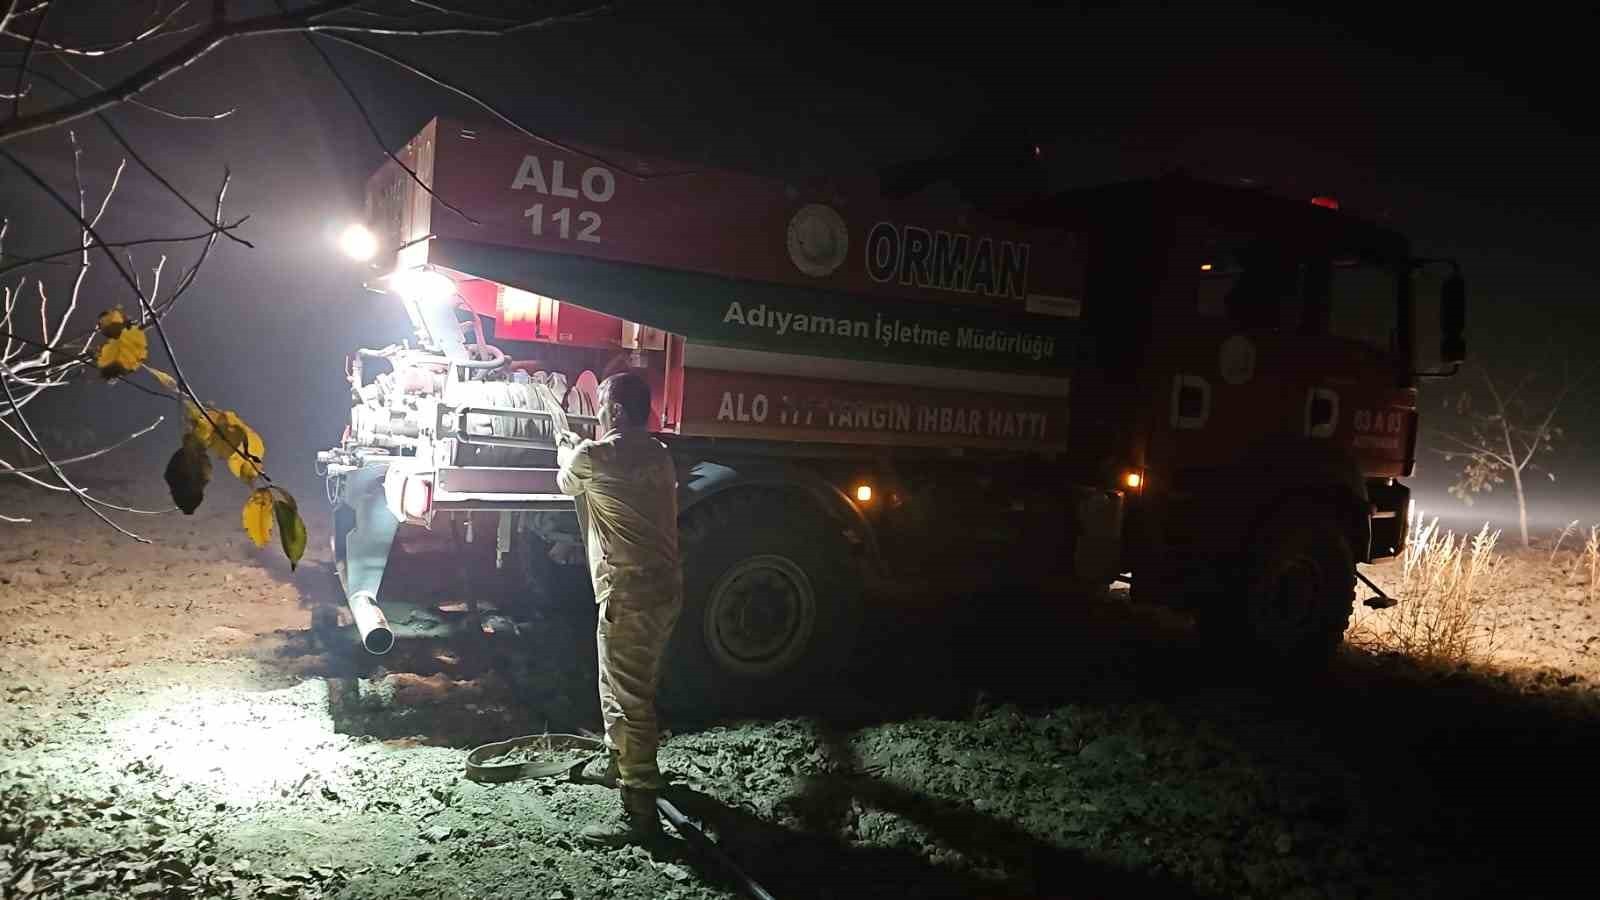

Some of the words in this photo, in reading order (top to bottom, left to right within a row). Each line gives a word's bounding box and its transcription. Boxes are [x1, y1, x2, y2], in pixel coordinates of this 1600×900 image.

[511, 154, 616, 203] ALO
[524, 204, 602, 243] 112
[865, 221, 1032, 299] ORMAN
[723, 301, 869, 340] Adıyaman
[874, 311, 951, 347] İşletme
[956, 326, 1055, 361] Müdürlüğü
[717, 391, 769, 424] ALO
[987, 408, 1048, 441] HATTI
